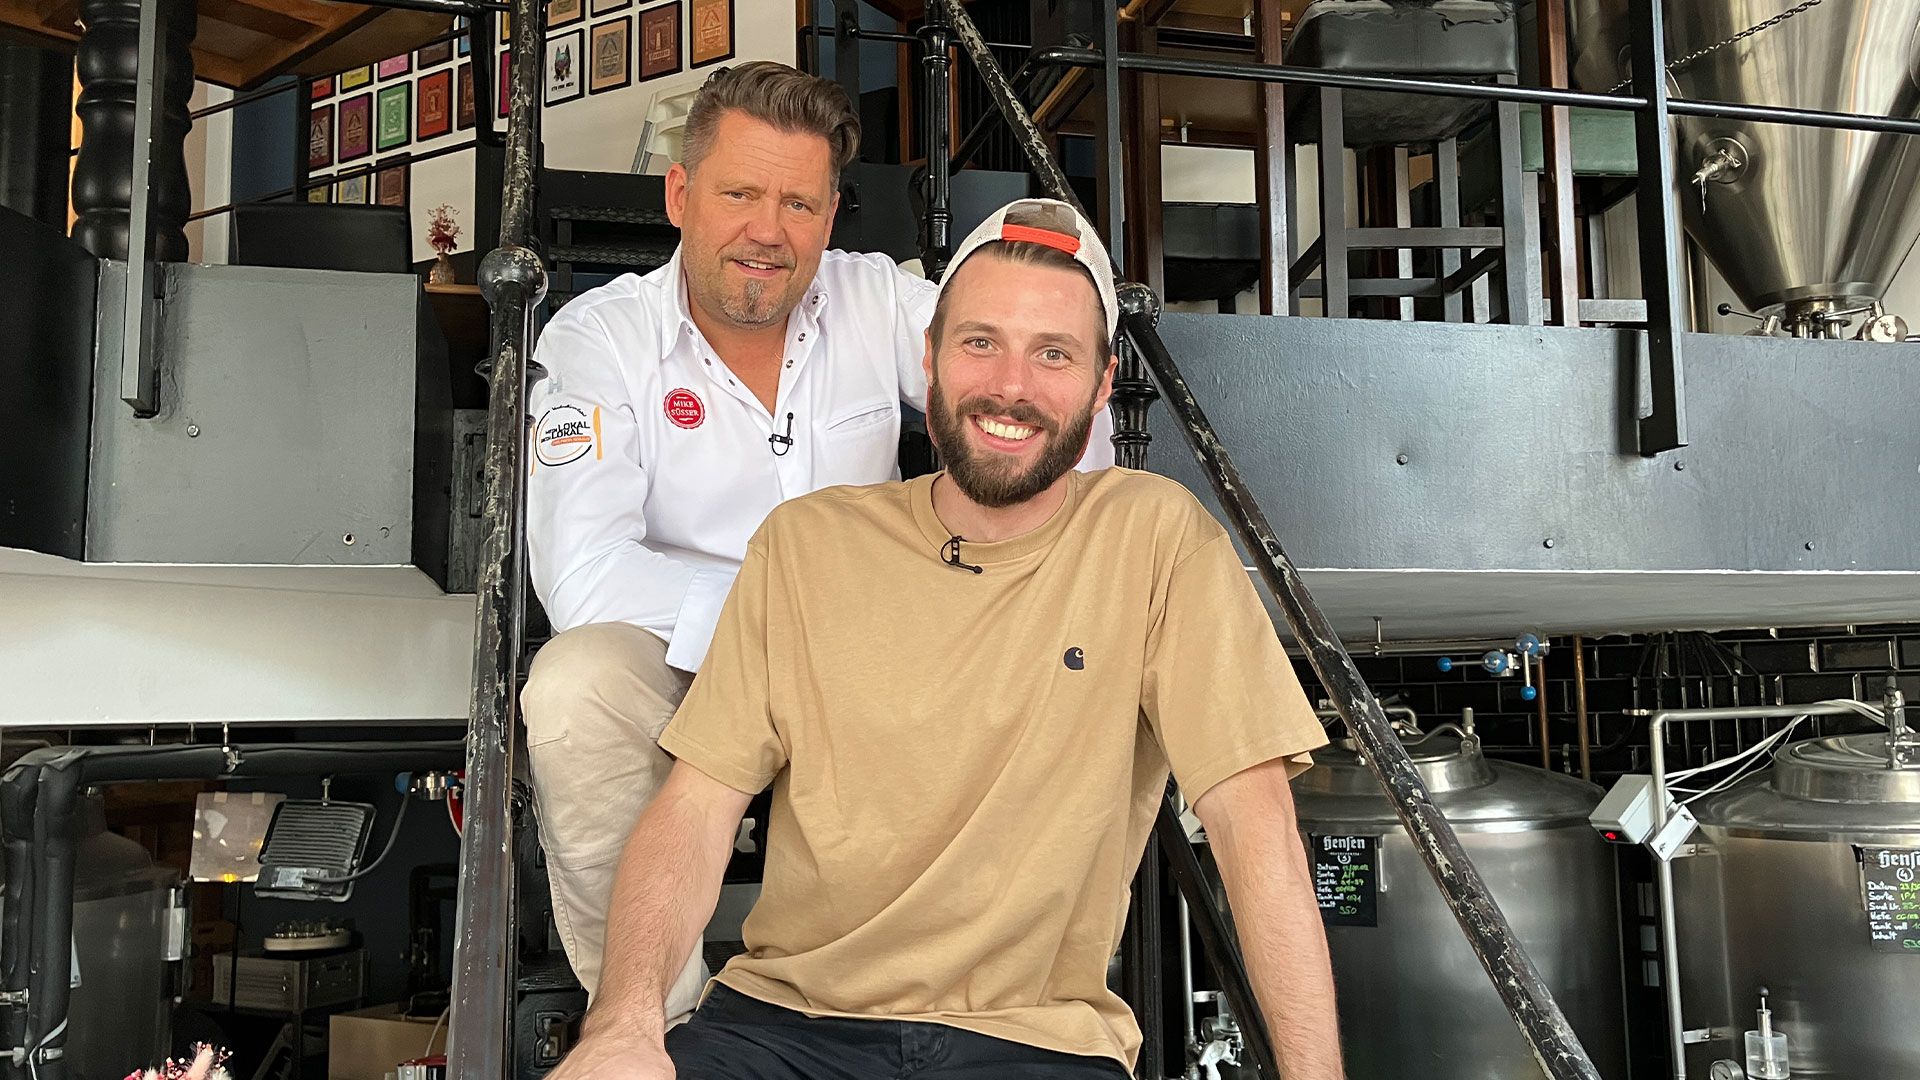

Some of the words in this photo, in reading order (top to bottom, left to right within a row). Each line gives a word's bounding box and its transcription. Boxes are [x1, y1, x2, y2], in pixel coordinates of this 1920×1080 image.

[673, 400, 694, 408] MIKE
[670, 407, 699, 417] SÜSSER
[558, 421, 591, 432] LOKAL
[551, 428, 583, 440] LOKAL
[1866, 881, 1898, 891] Datum
[1868, 891, 1894, 901] Sorte
[1870, 911, 1892, 921] Hefe
[1870, 921, 1892, 931] Tank
